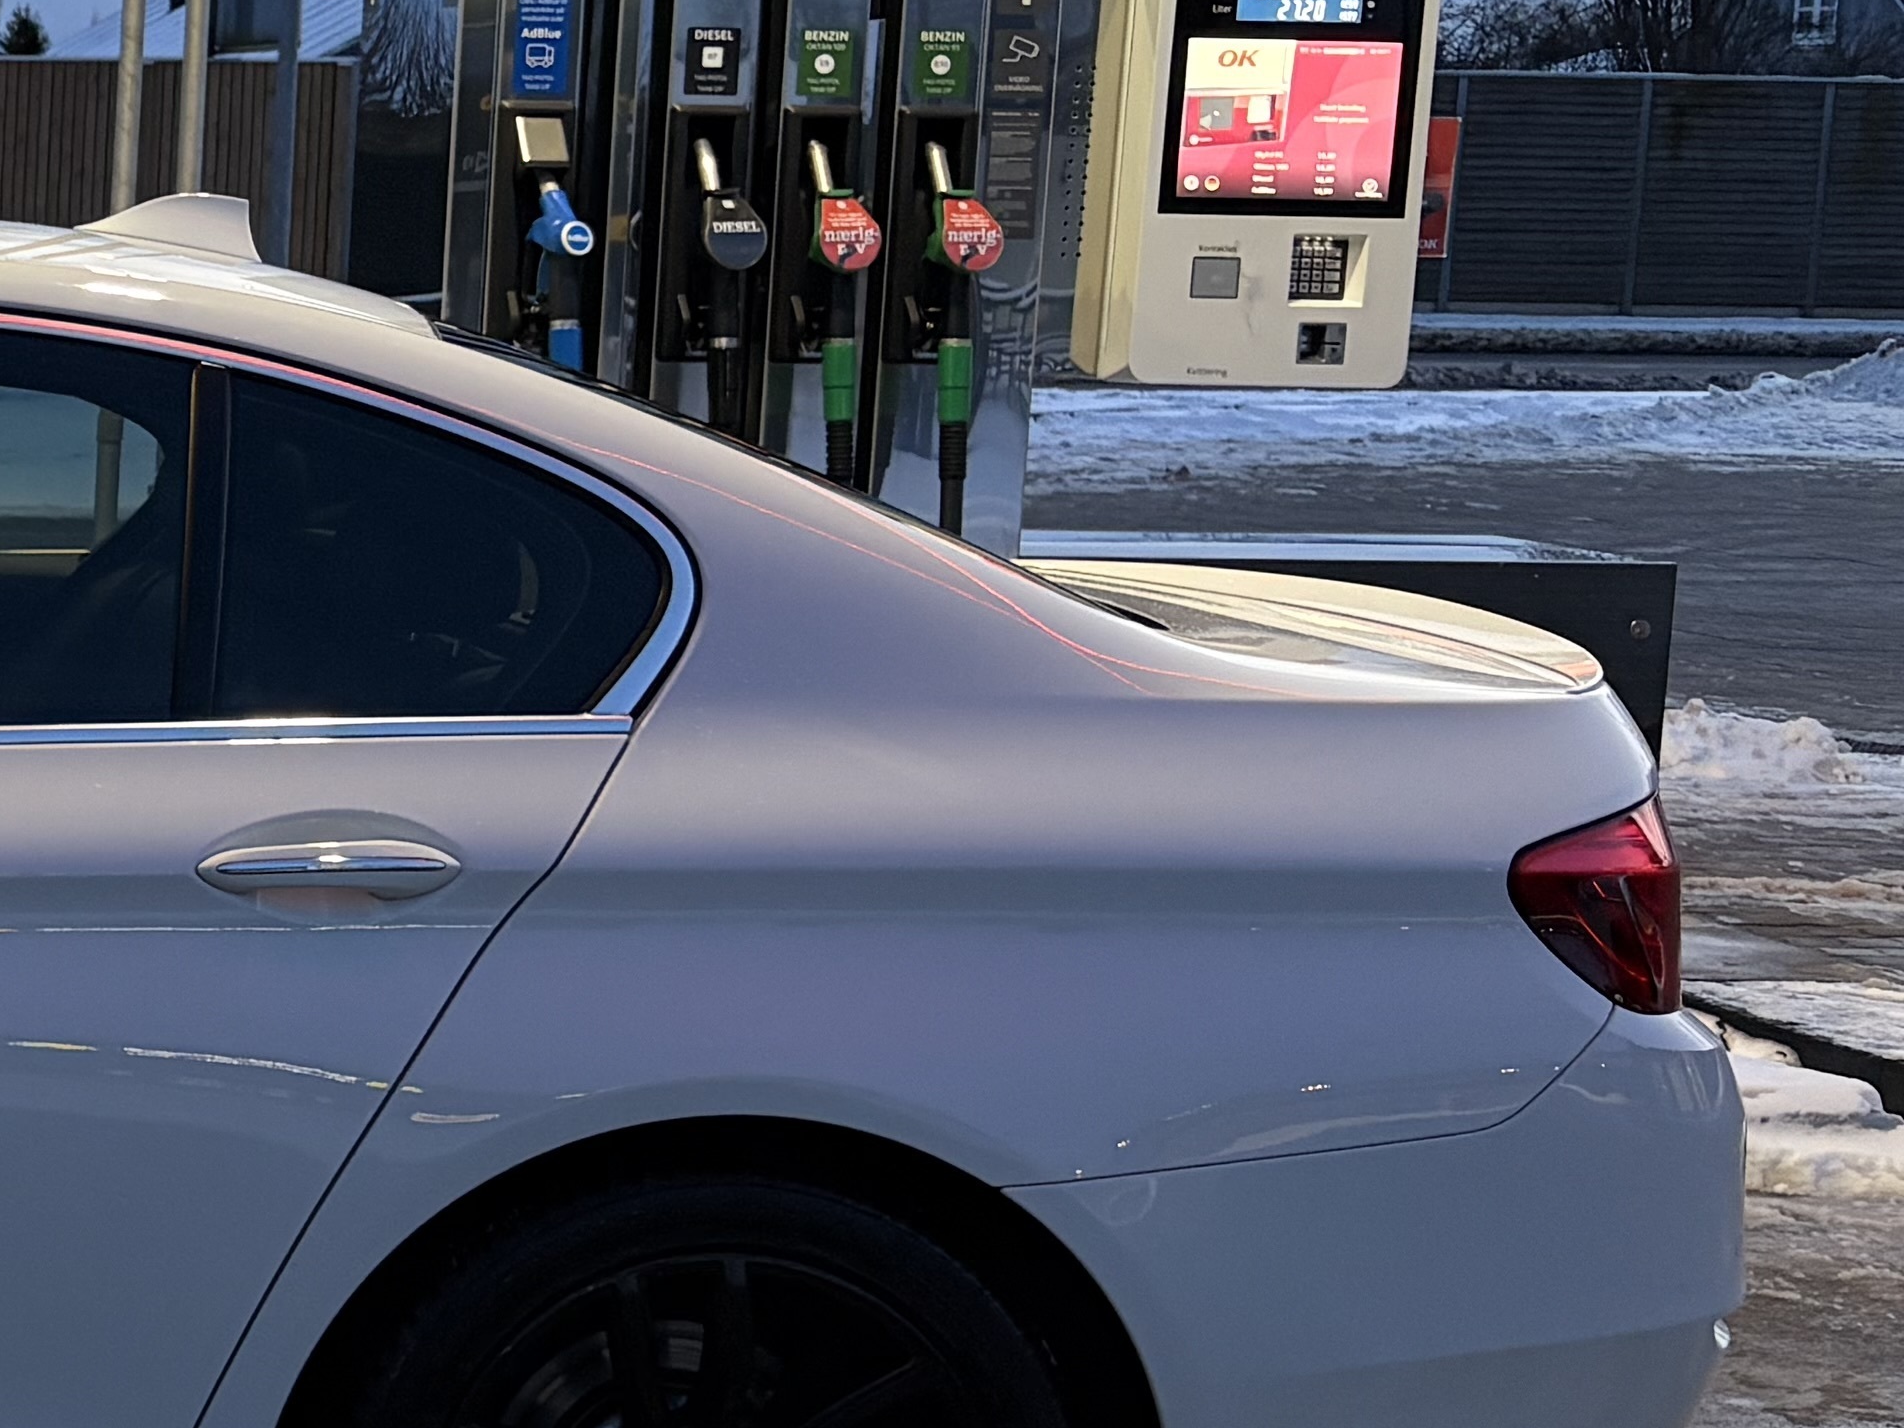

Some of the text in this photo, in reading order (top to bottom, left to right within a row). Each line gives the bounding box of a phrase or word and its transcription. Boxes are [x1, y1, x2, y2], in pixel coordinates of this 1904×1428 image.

[521, 27, 562, 40] AdBlue
[694, 28, 734, 42] DIESEL
[804, 30, 849, 42] BENZIN
[920, 31, 966, 43] BENZIN
[1218, 49, 1259, 67] OK
[713, 221, 761, 234] DIESEL
